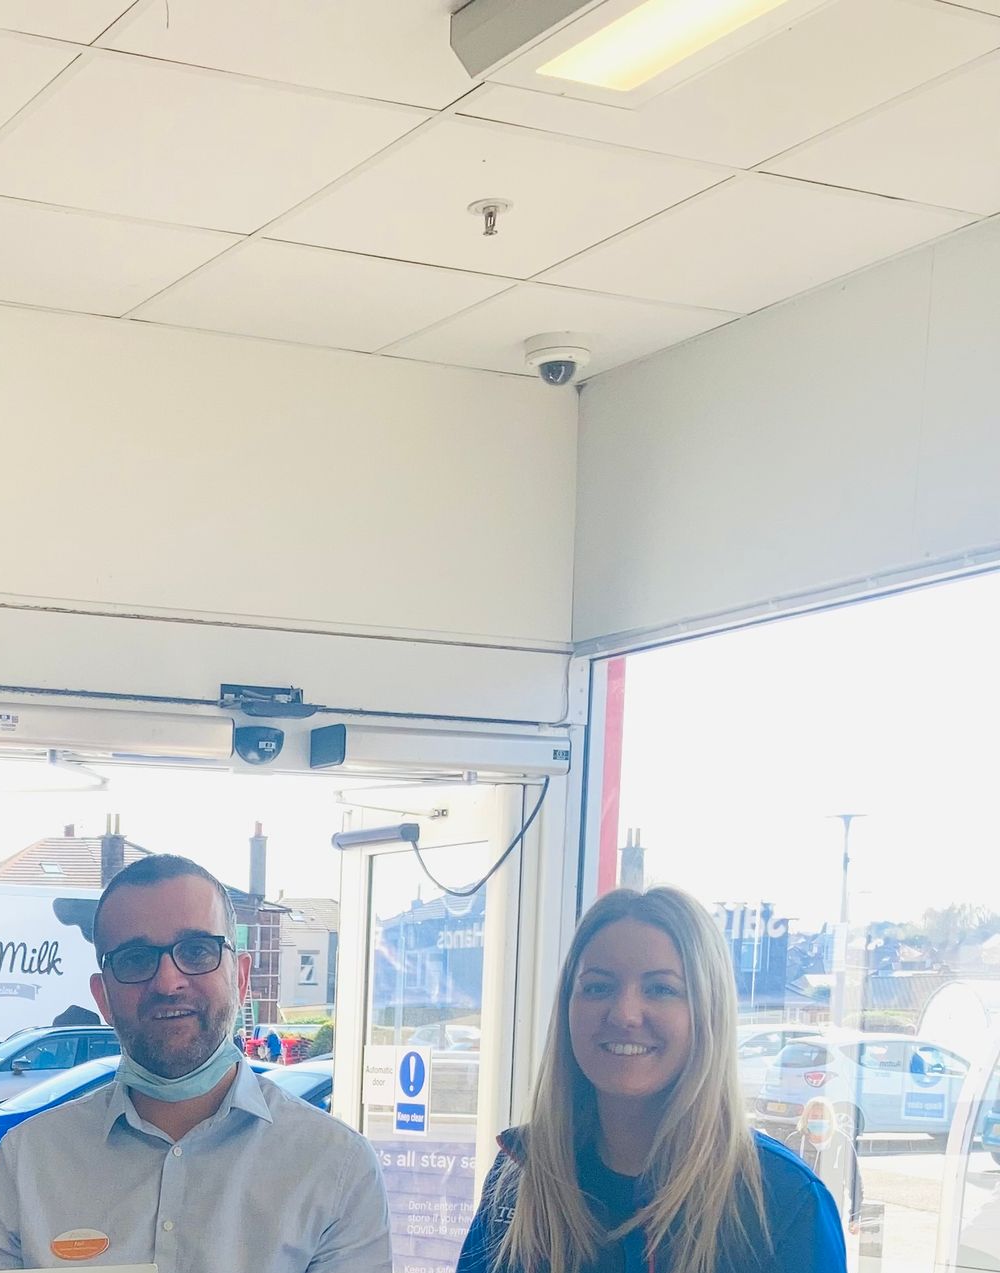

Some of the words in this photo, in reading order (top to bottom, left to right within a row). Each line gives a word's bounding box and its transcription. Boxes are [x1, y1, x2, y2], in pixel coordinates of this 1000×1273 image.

[396, 1151, 416, 1168] all
[420, 1152, 456, 1172] stay
[407, 1225, 448, 1235] COVID-19
